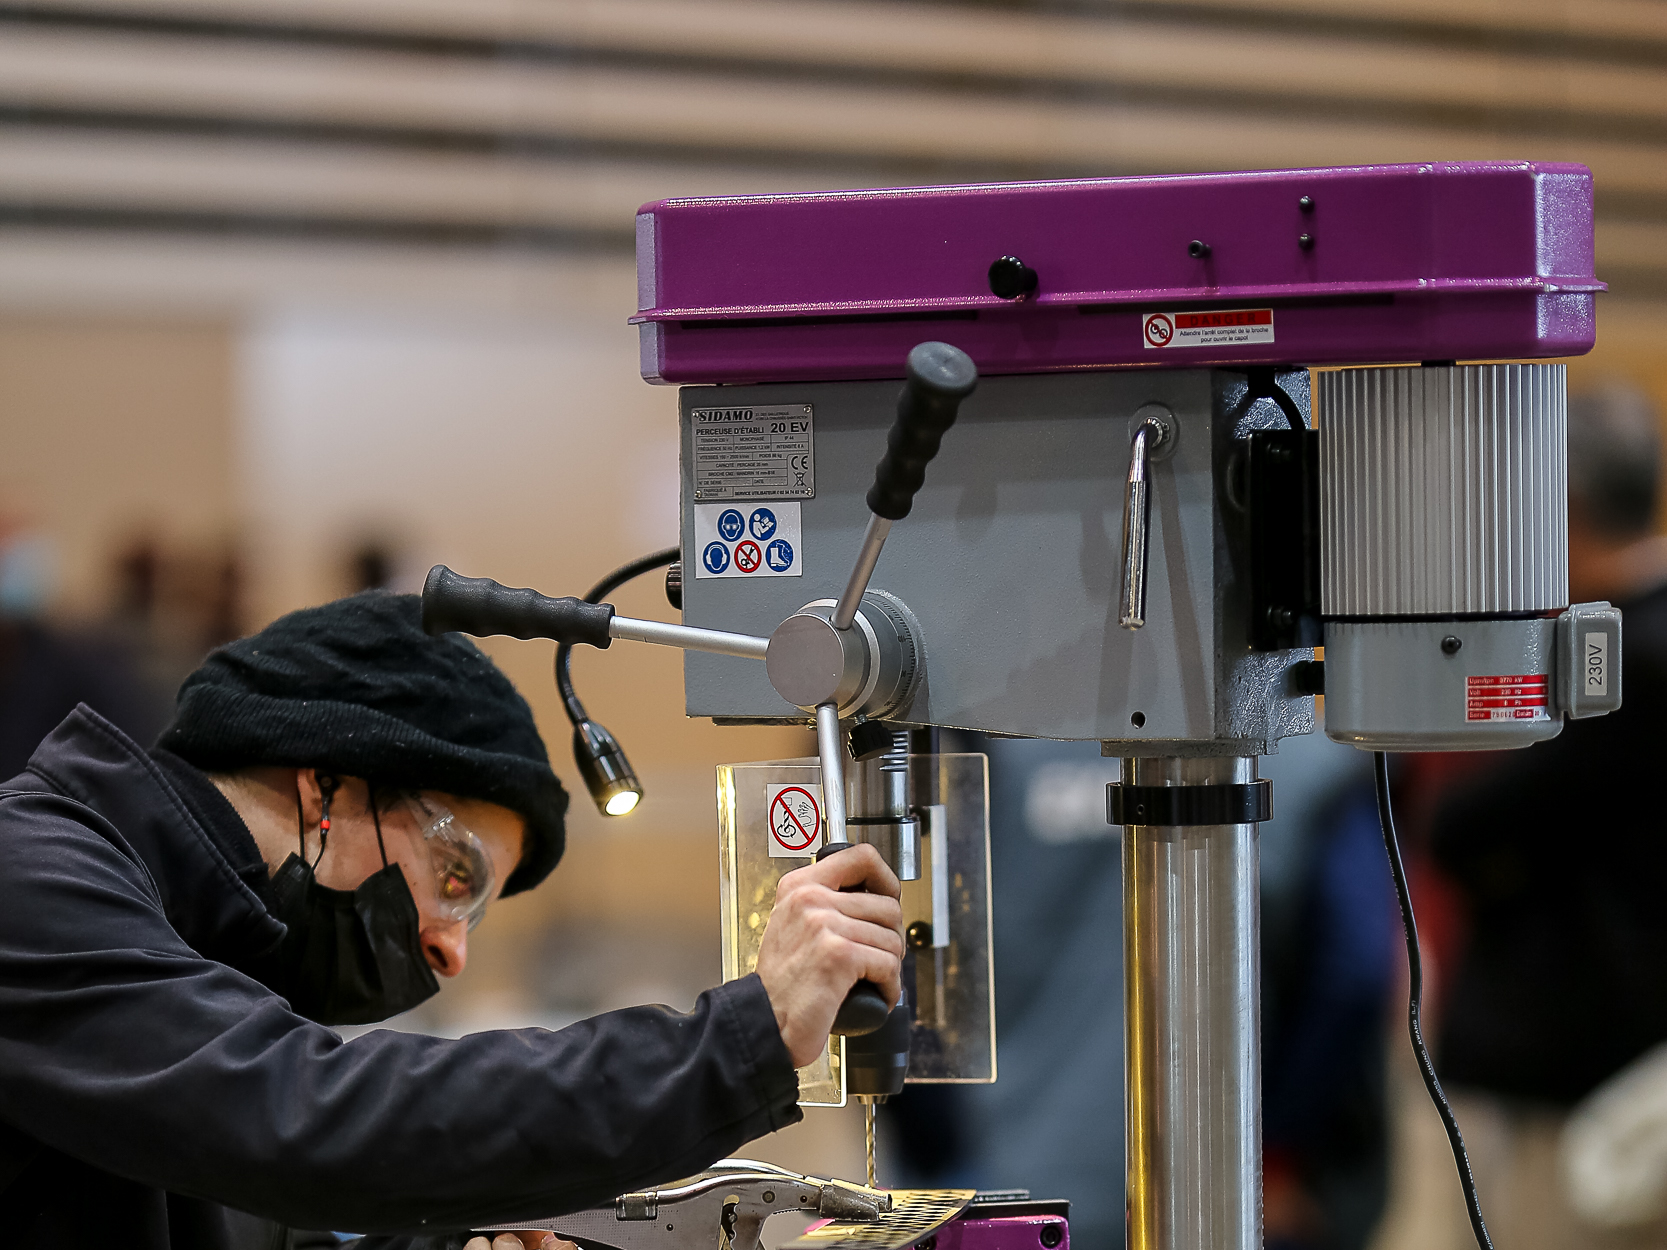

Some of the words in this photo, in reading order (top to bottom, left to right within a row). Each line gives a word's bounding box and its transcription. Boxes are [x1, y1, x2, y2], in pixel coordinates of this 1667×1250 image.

[1191, 313, 1256, 326] DANGER
[699, 410, 753, 421] SIDAMO
[734, 426, 764, 434] D'ÉTABLI
[771, 423, 786, 433] 20
[791, 422, 809, 432] EV
[1588, 644, 1602, 685] 230V
[1413, 1020, 1422, 1044] KWANG
[1421, 1050, 1434, 1075] CHUNG
